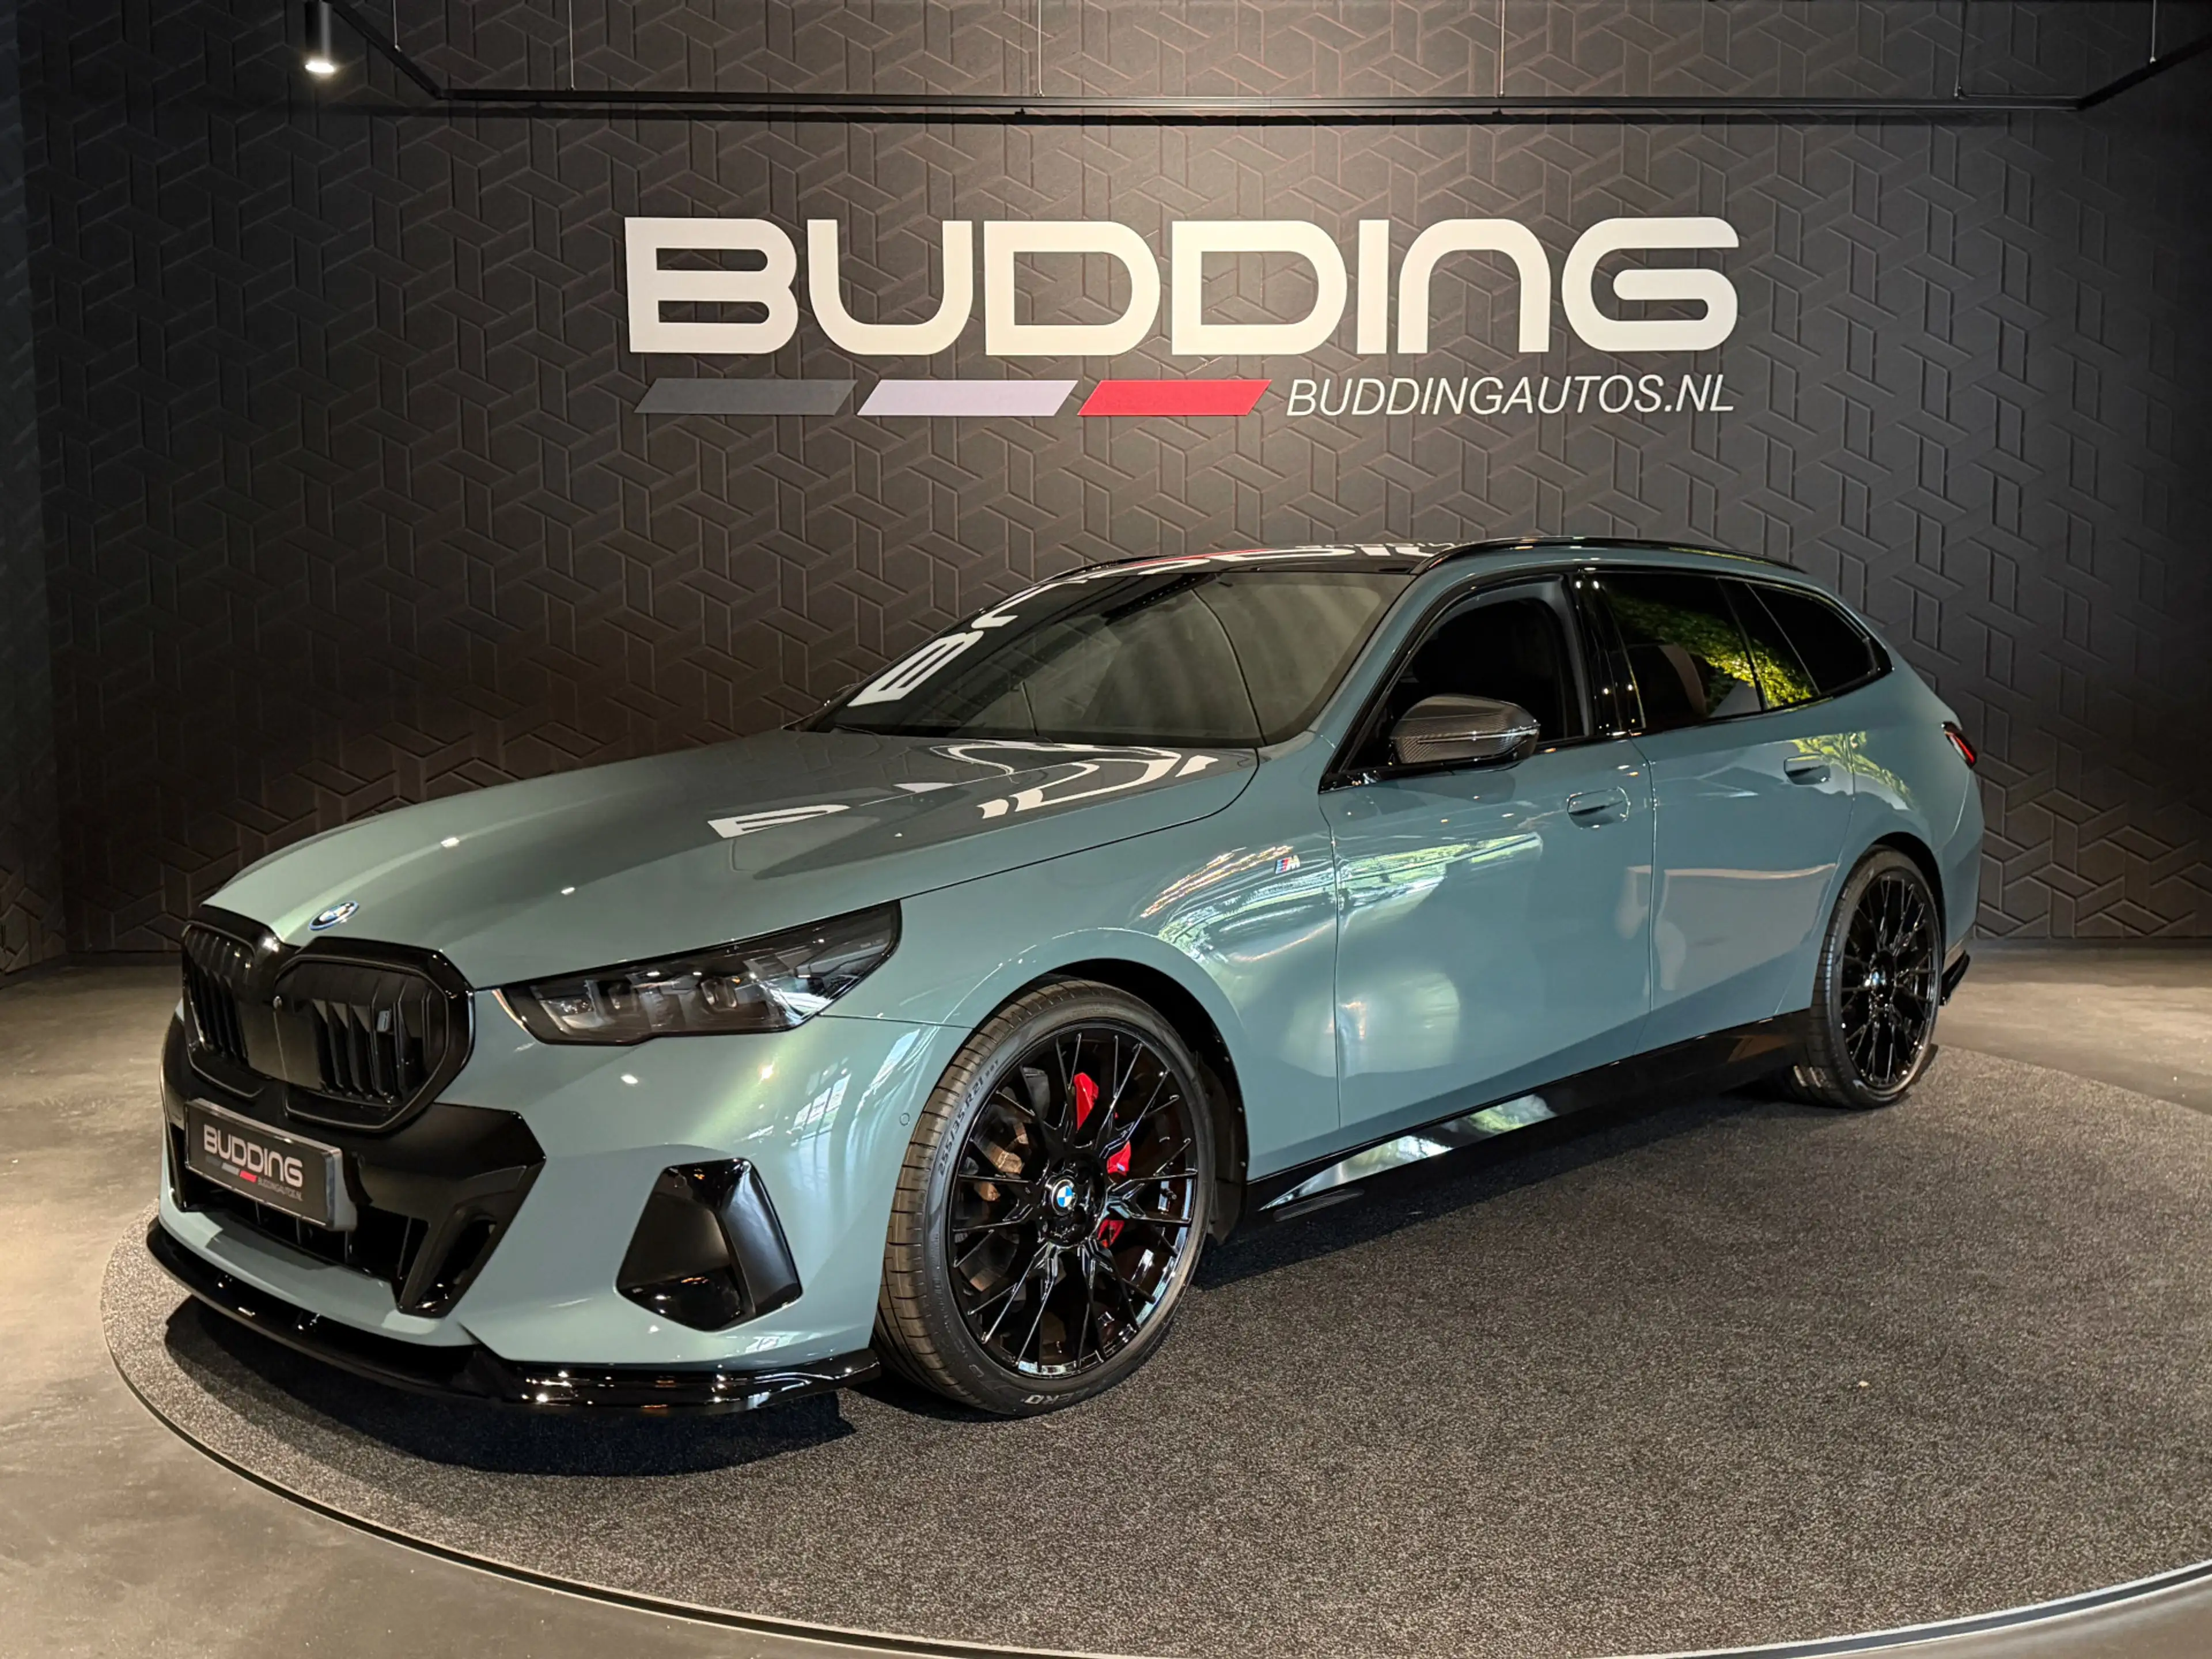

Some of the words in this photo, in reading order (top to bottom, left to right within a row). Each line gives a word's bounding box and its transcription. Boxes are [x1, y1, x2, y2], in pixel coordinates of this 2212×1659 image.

[624, 217, 1738, 355] BUDDING
[1286, 374, 1734, 416] BUDDINGAUTOS.NL
[203, 1124, 303, 1187] BUDDING
[938, 1109, 965, 1176] 255/35
[964, 1075, 984, 1109] R21
